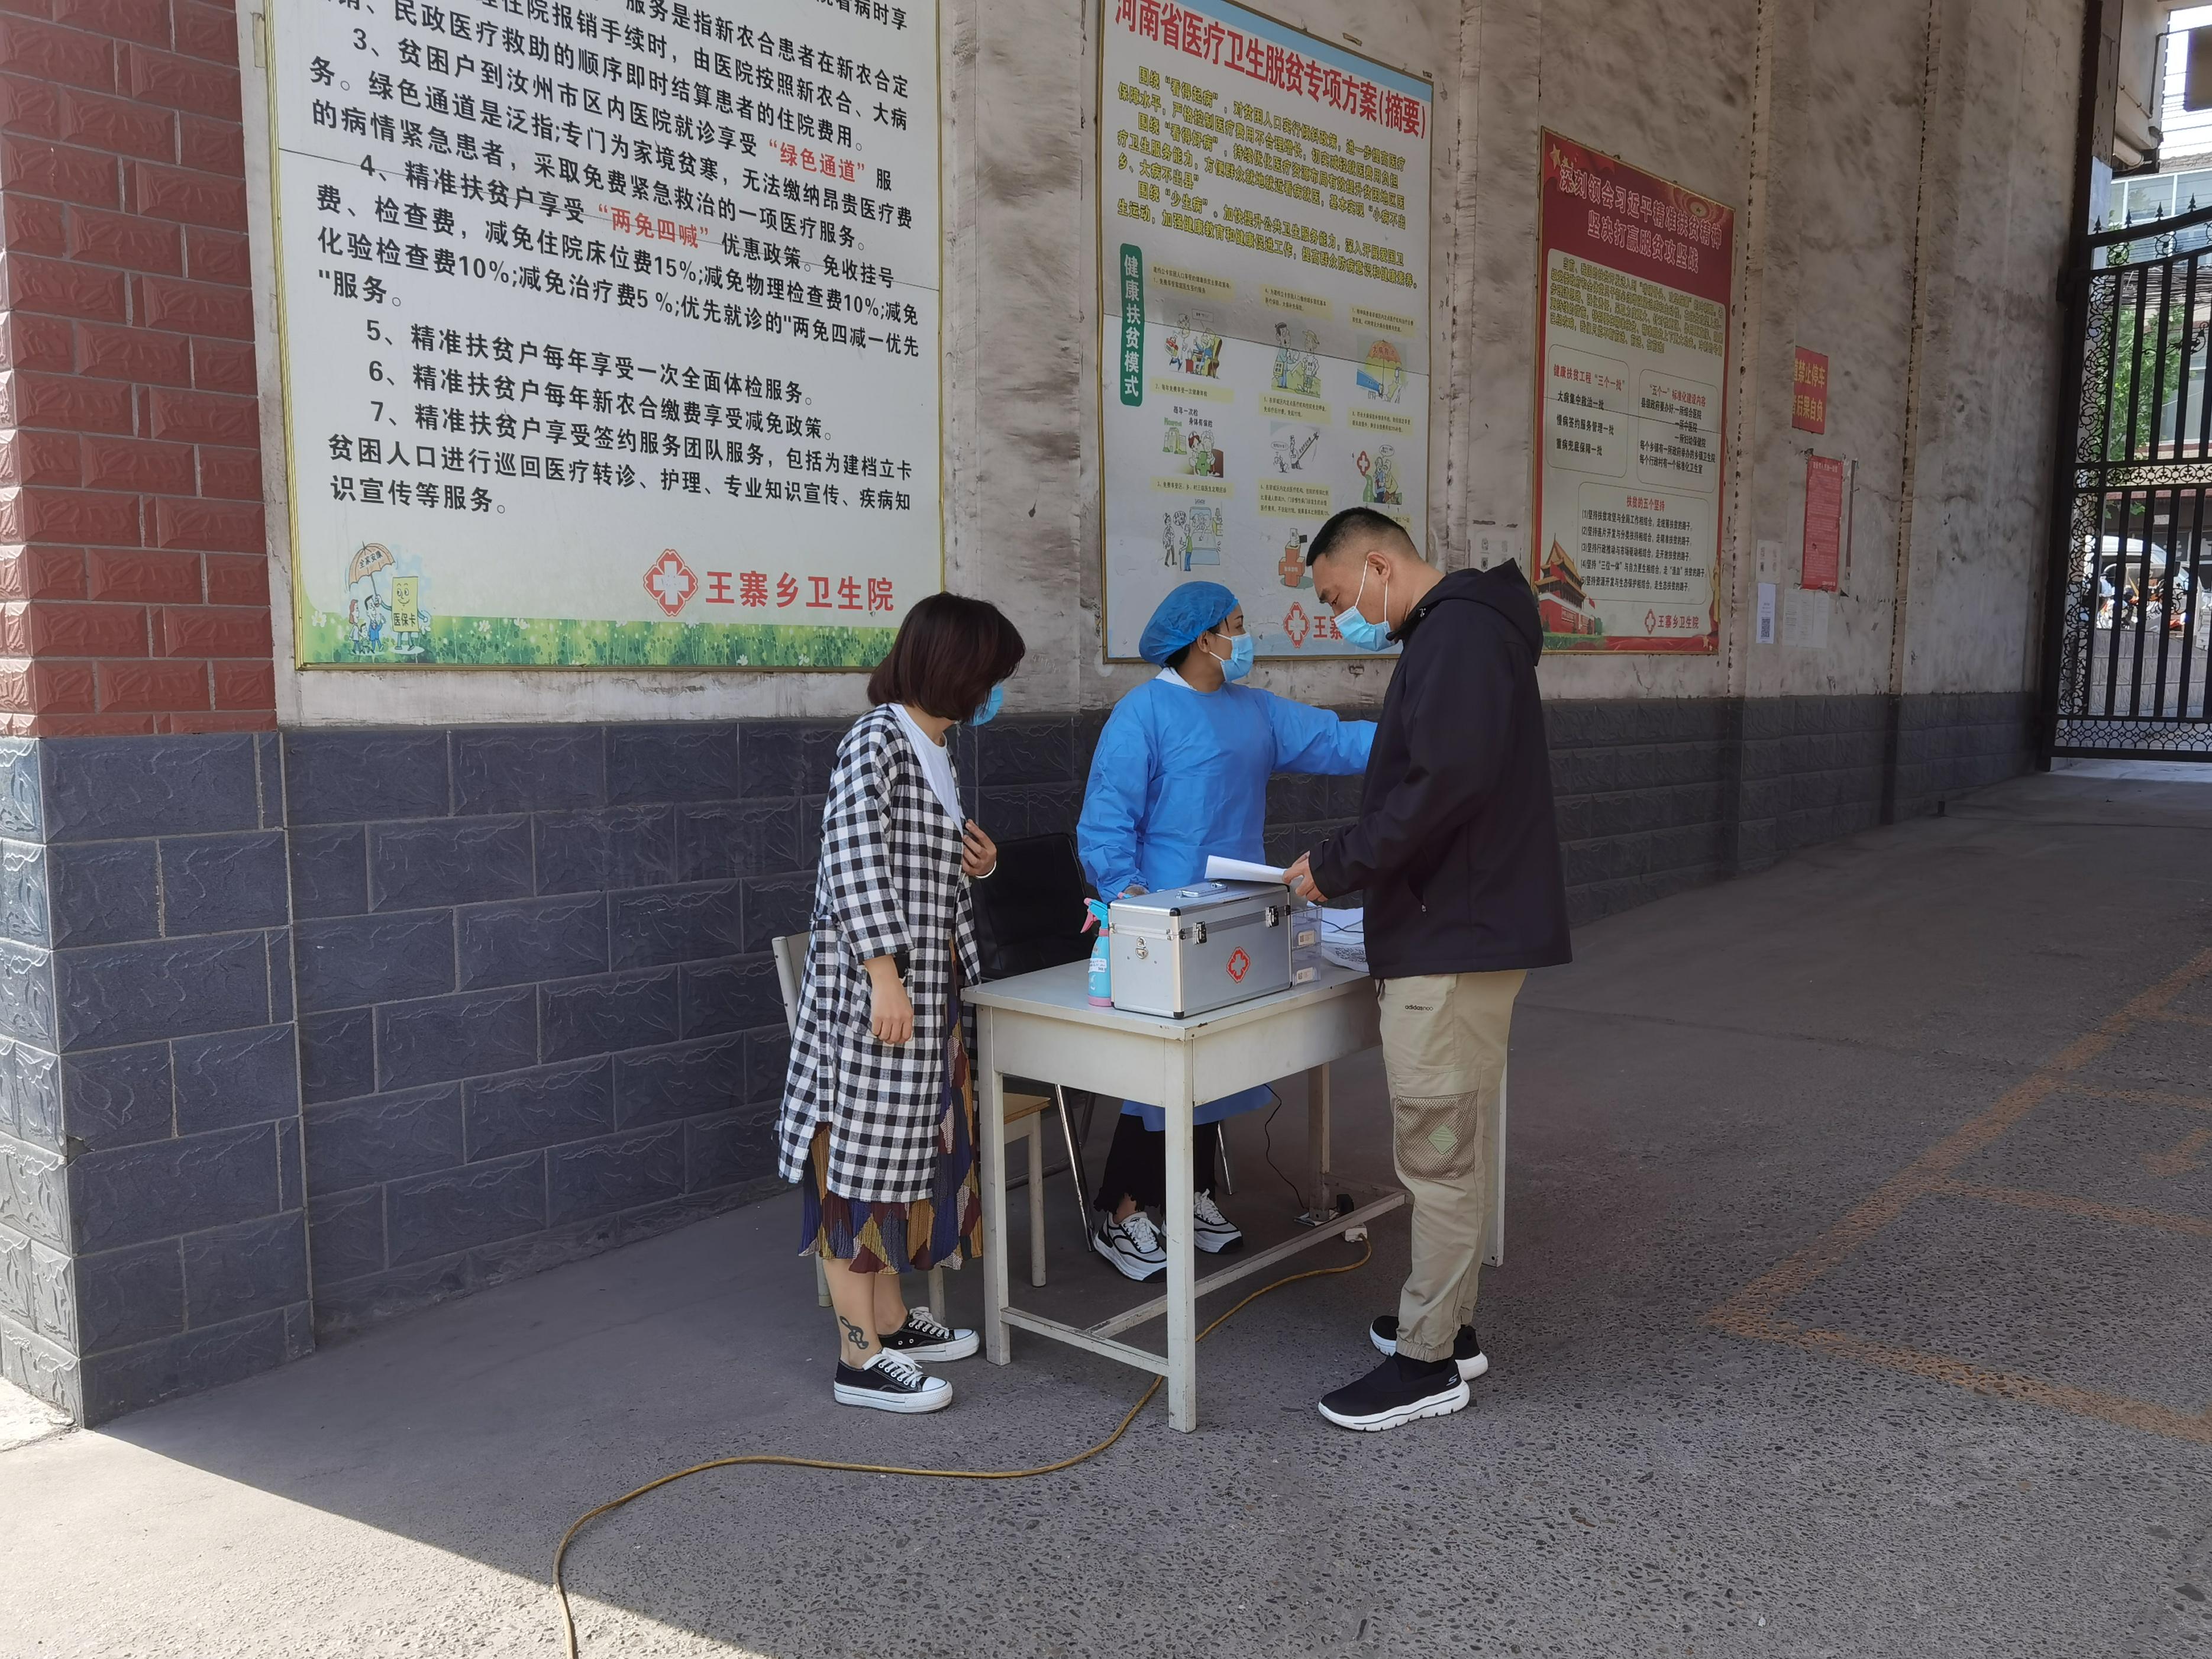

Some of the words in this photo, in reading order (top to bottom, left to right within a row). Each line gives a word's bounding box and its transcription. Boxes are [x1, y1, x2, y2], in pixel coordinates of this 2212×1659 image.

[816, 0, 908, 30] 看病时享
[1559, 163, 1722, 250] 深刻领会习近平精准扶贫精神
[1587, 209, 1700, 273] 坚决打赢脱贫攻坚战
[1123, 253, 1140, 398] 健康扶贫模式
[1557, 390, 1604, 411] 大病集中救治一批
[1556, 414, 1614, 436] 慢病签约服务管理一批
[1556, 438, 1603, 456] 重病兜底保障一批
[1626, 495, 1665, 512] 扶贫的五个坚持
[706, 570, 894, 611] 王寨乡卫生院
[393, 612, 415, 627] 医保卡
[1657, 614, 1700, 630] 王寨乡卫生院
